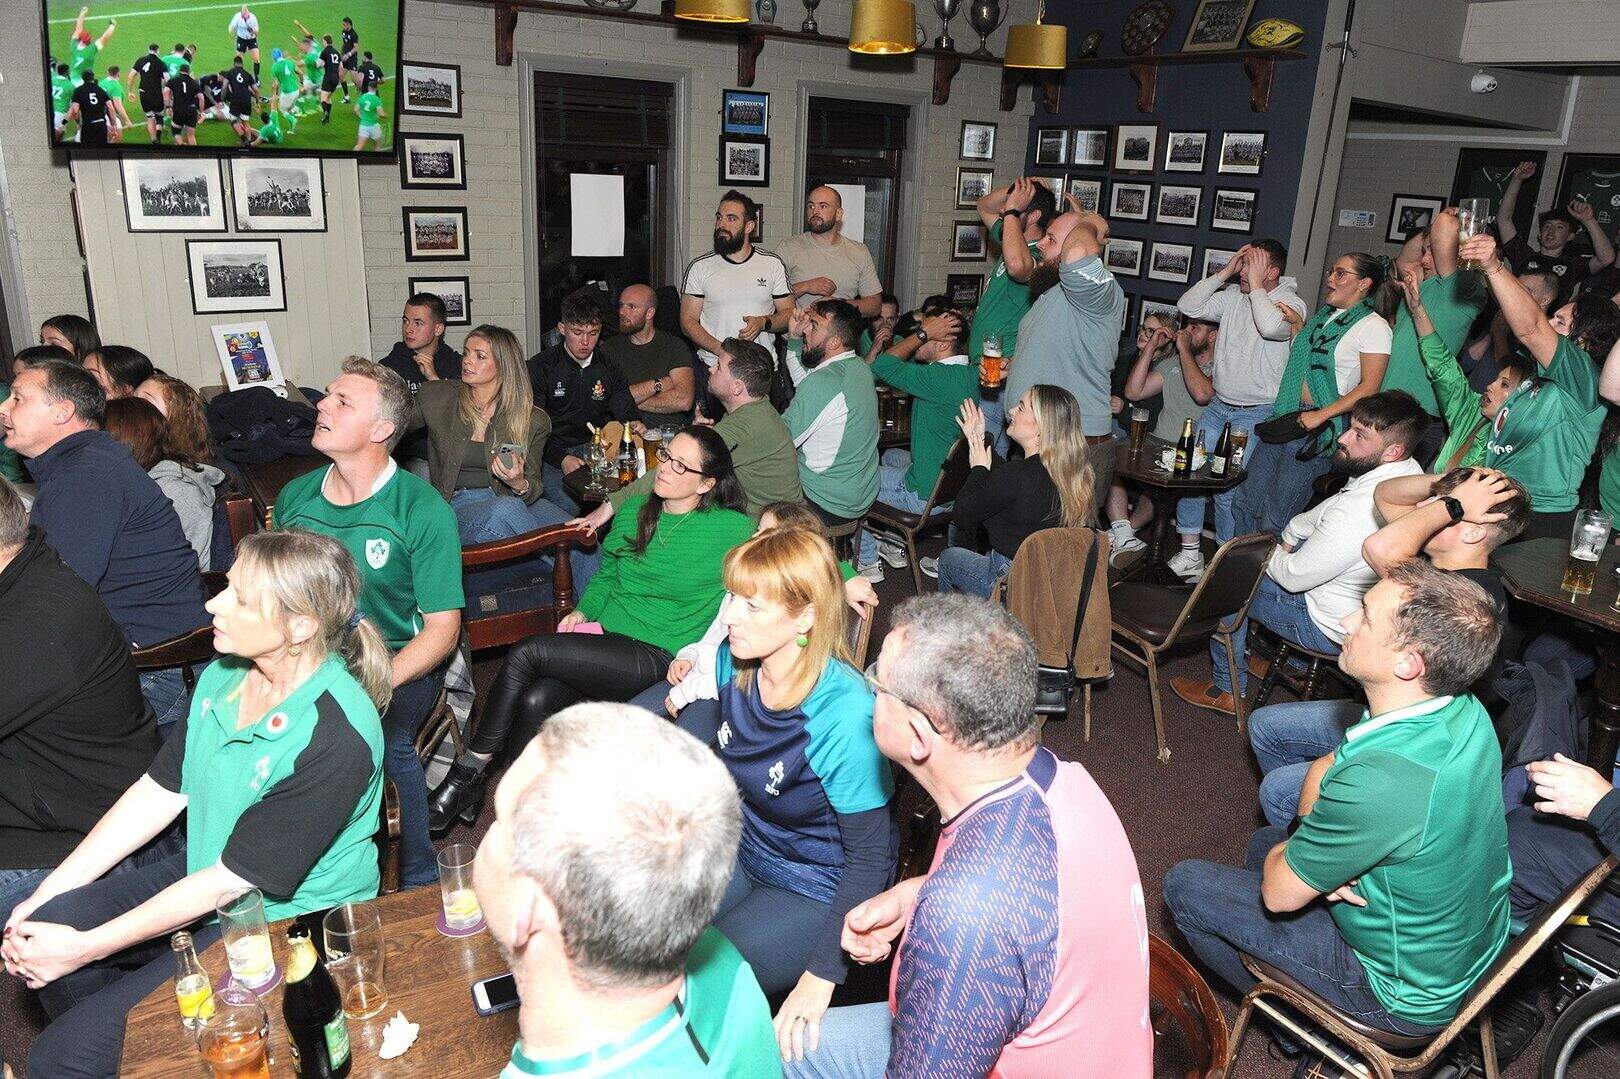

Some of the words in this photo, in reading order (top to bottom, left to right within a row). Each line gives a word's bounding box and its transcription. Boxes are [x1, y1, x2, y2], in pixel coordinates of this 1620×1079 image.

[330, 53, 339, 64] 12
[142, 62, 151, 73] 4
[236, 73, 244, 83] 6
[368, 69, 375, 80] 3
[182, 81, 187, 94] 1
[88, 92, 99, 105] 5
[363, 100, 371, 111] 2
